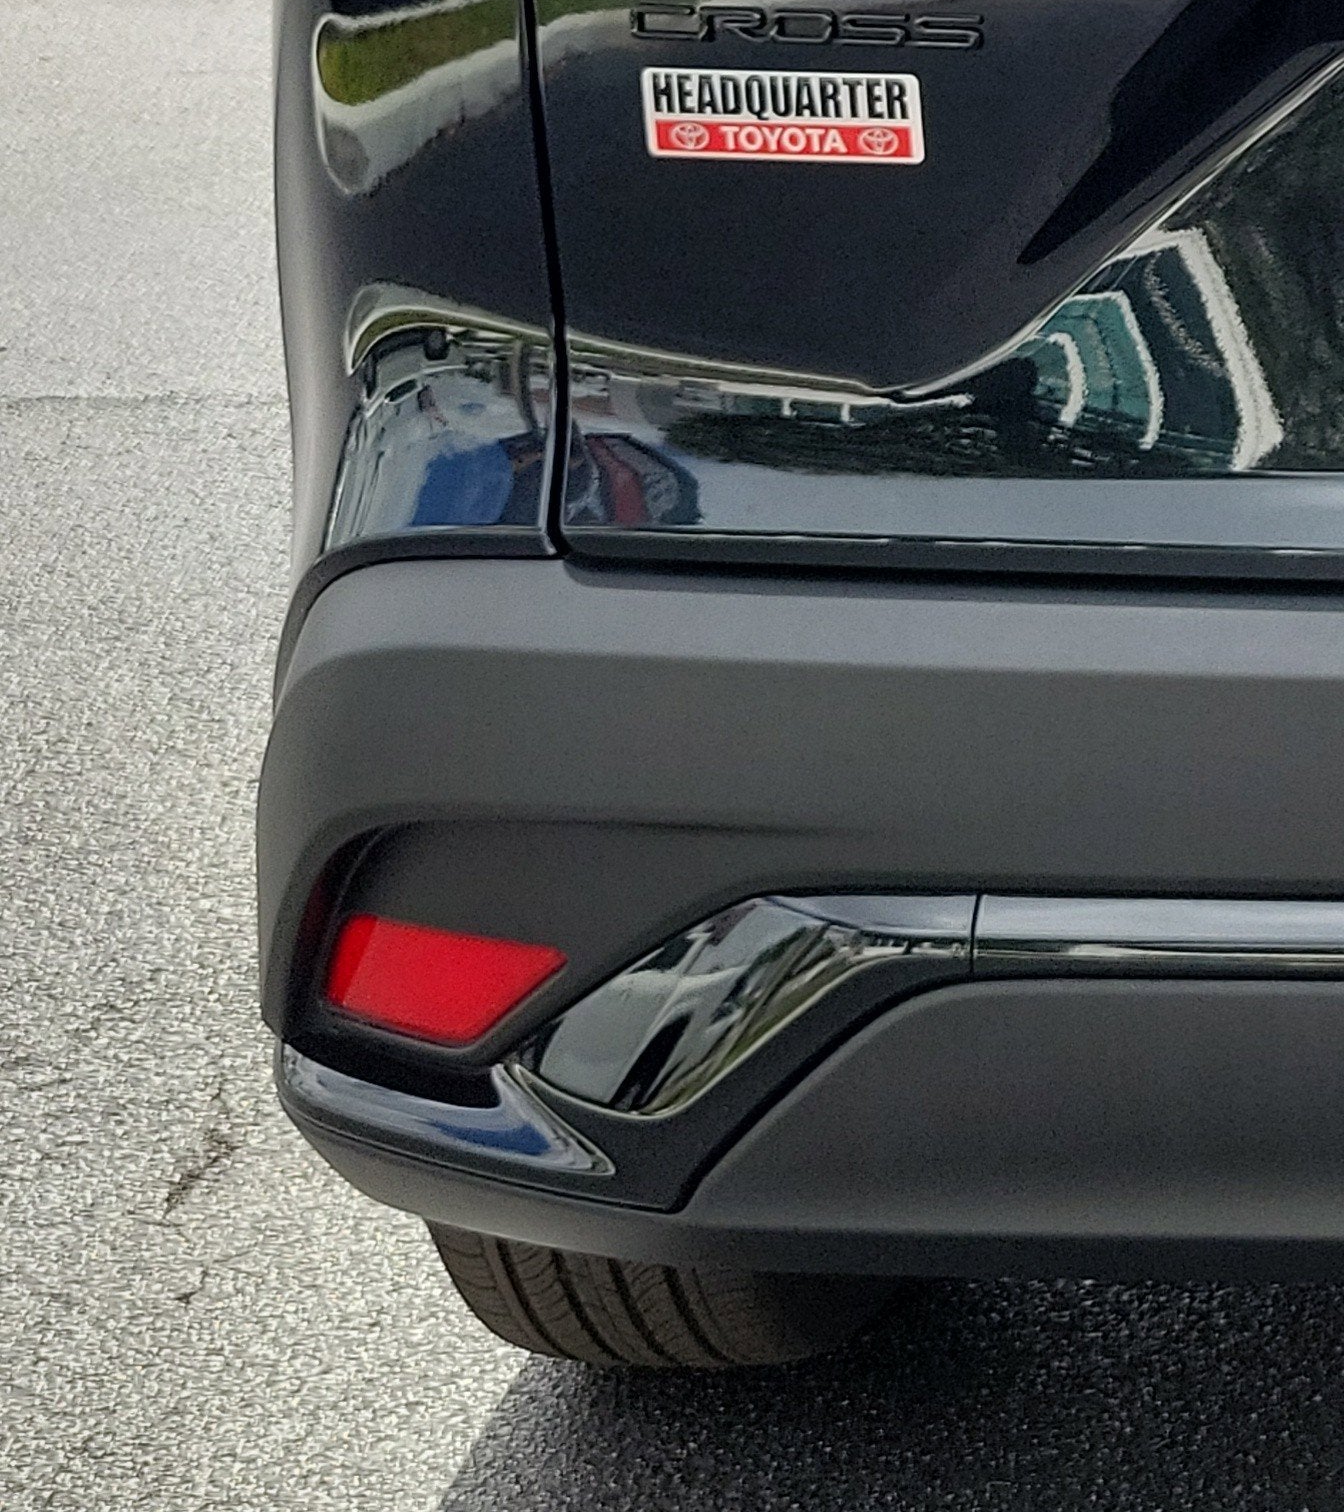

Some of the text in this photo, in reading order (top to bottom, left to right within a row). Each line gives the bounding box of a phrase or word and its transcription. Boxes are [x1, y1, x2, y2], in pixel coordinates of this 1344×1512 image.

[630, 3, 985, 49] CROSS
[652, 71, 911, 121] HEADQUARTER
[719, 124, 848, 155] TOYOTA
